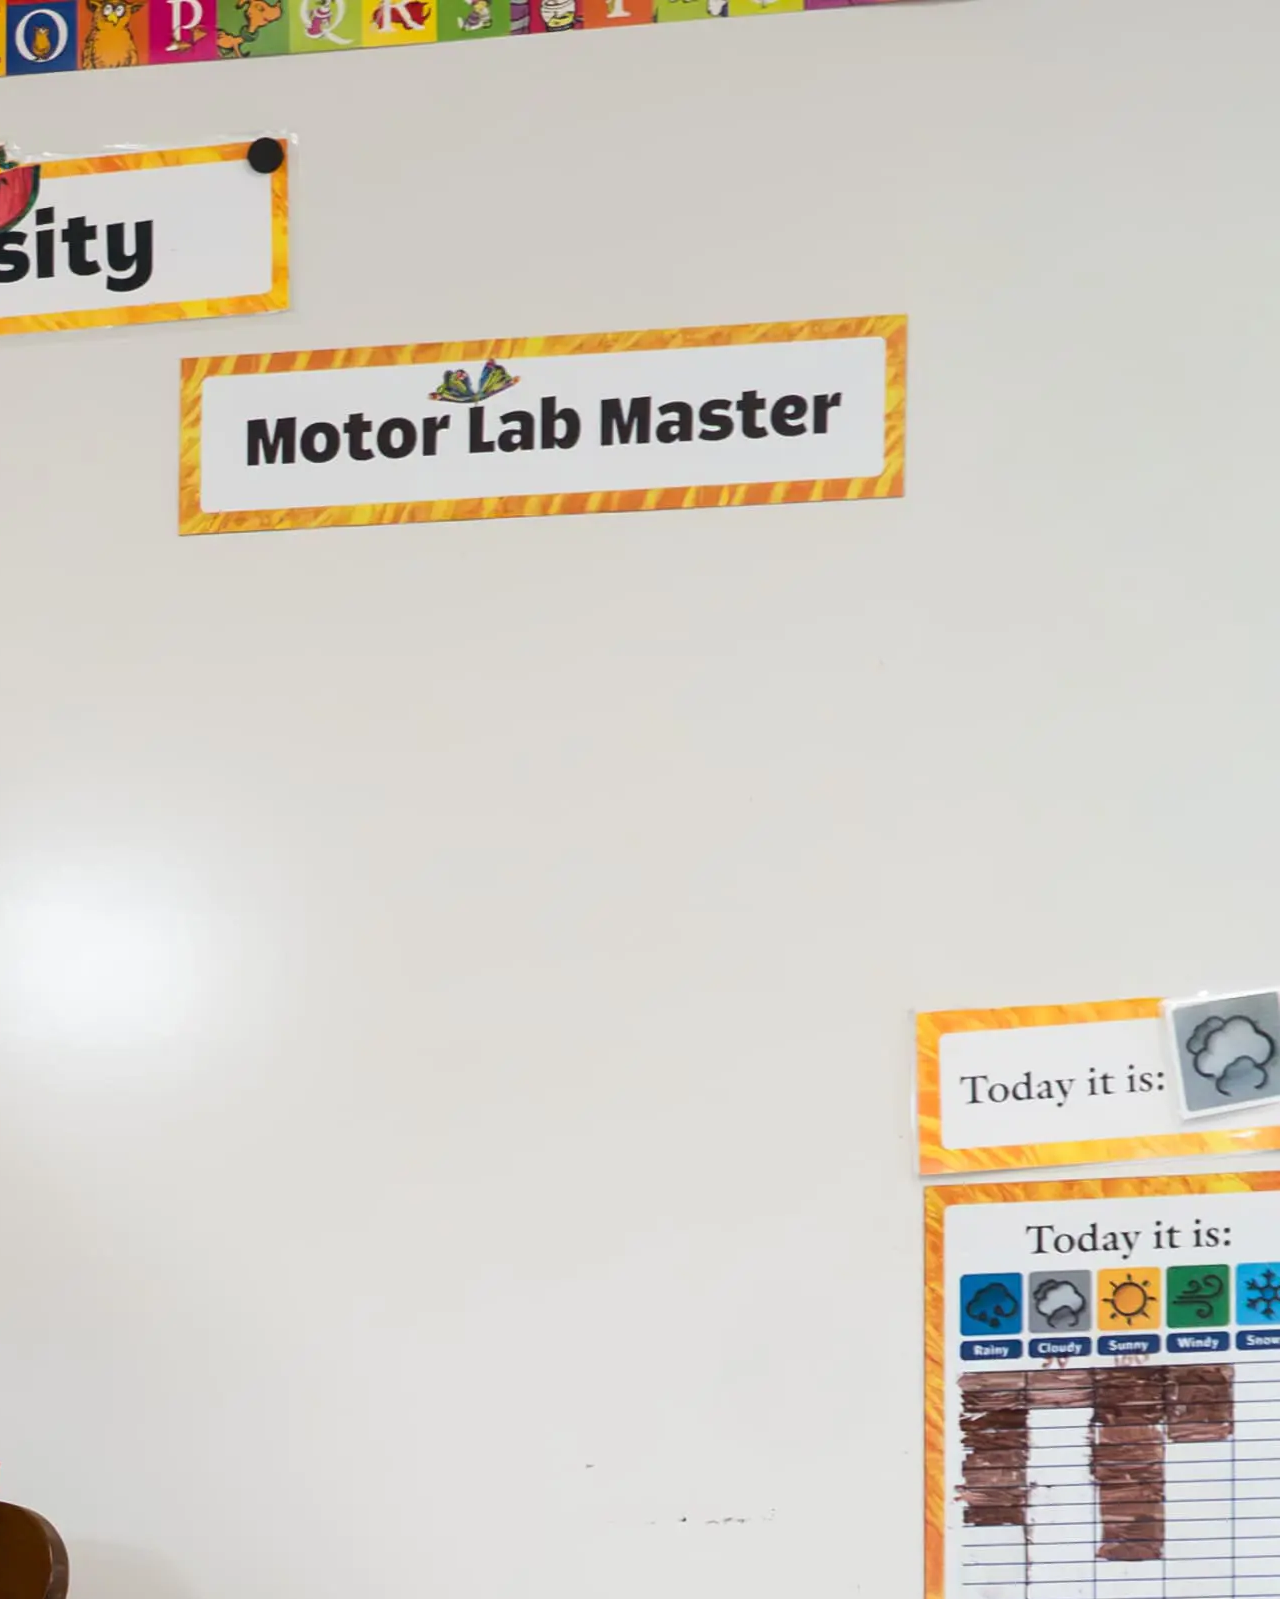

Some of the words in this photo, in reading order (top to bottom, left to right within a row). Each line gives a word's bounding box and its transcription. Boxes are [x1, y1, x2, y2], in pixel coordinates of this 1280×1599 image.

[246, 410, 451, 466] Motor
[468, 396, 581, 453] Lab
[600, 388, 842, 446] Master
[959, 1070, 1076, 1107] Today
[1087, 1067, 1115, 1096] it
[1127, 1064, 1165, 1093] is:
[1026, 1223, 1142, 1260] Today
[1153, 1220, 1182, 1250] it
[1193, 1218, 1233, 1248] is:
[973, 1343, 1010, 1359] Rainy
[1037, 1341, 1083, 1356] Cloudy
[1107, 1339, 1149, 1353] Sunny
[1177, 1335, 1219, 1350] Windy
